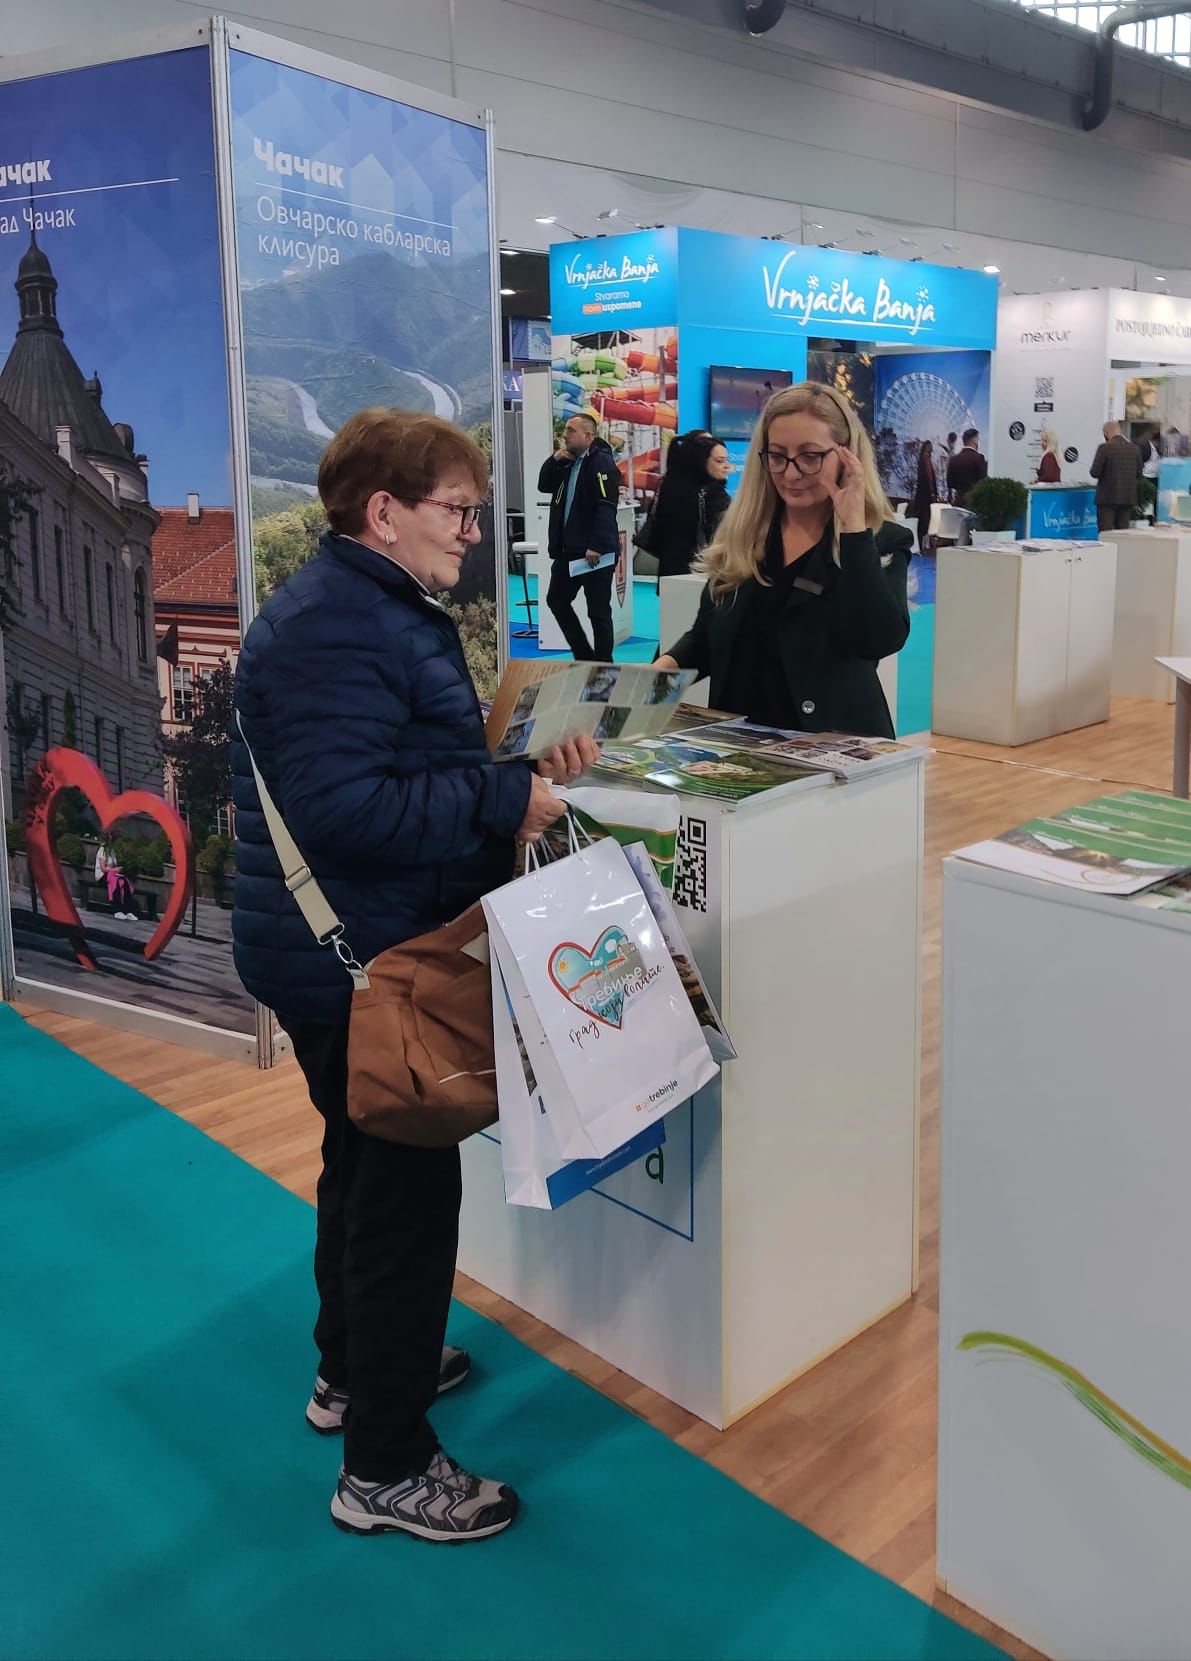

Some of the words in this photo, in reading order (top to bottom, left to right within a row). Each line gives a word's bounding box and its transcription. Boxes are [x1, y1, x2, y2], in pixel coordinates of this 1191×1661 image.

[0, 160, 52, 187] ачак
[254, 137, 344, 188] Чачак
[22, 207, 76, 231] Чачак
[257, 195, 358, 237] Овчарско
[364, 223, 450, 257] кабларска
[258, 234, 340, 270] клисура
[565, 253, 617, 289] Vrnjačka
[621, 255, 659, 283] Banja
[602, 300, 642, 313] uspomene
[763, 250, 867, 326] Vrnjačka
[873, 277, 936, 336] Banja
